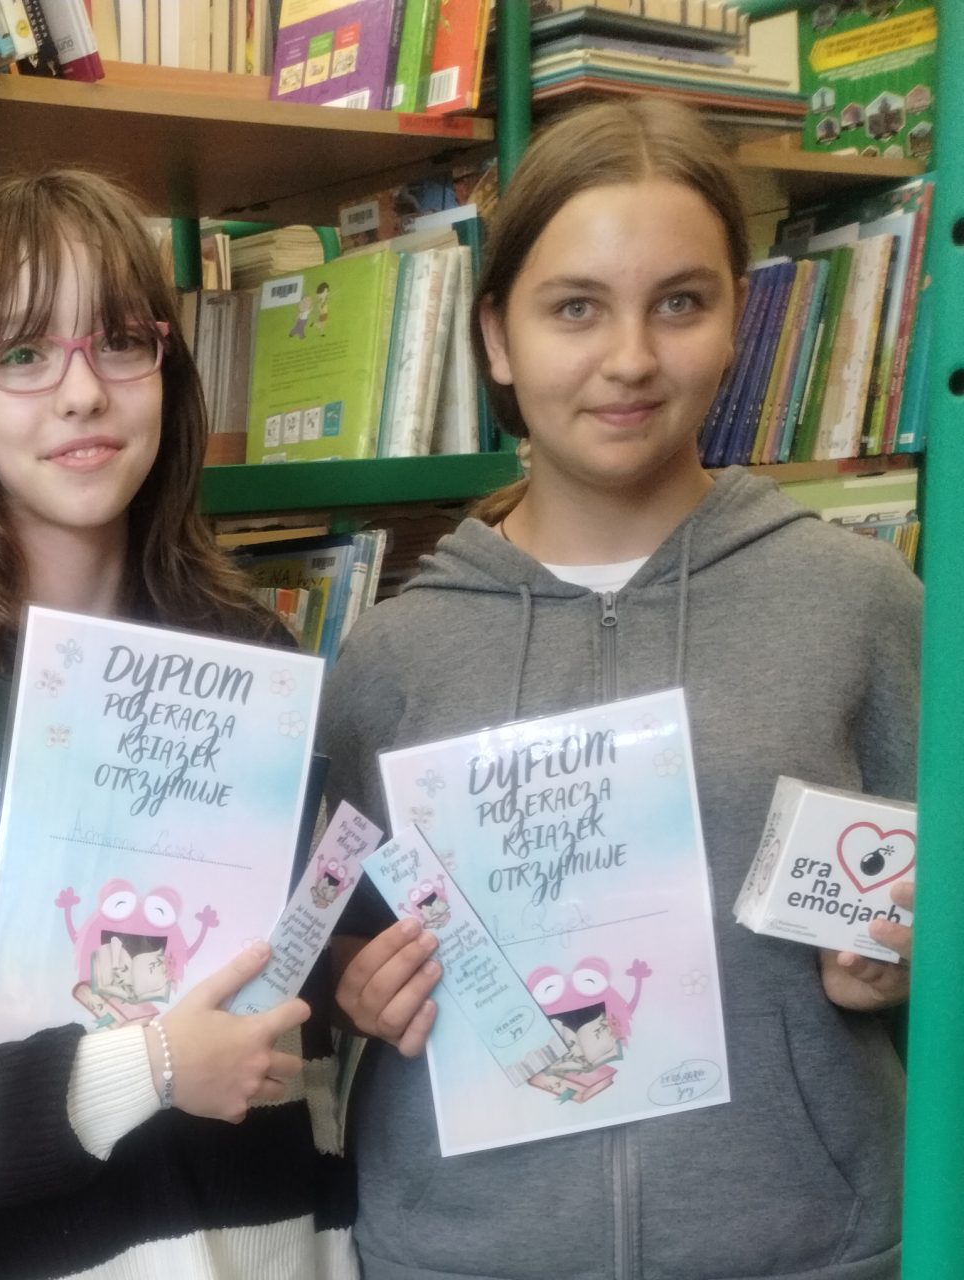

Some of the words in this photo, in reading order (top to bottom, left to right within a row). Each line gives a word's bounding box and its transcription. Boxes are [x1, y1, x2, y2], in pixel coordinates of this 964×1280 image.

[102, 645, 254, 706] DYPLOM
[103, 693, 236, 745] POŻERACZA
[117, 733, 220, 777] KSIĄŻEK
[468, 729, 617, 798] DYPLOM
[94, 763, 235, 817] OTRZYMUJE
[477, 778, 612, 836] POŻERACZA
[502, 812, 606, 857] KSIĄŻEK
[488, 844, 628, 906] OTRZYMUJE
[790, 857, 832, 879] gra
[811, 878, 841, 898] na
